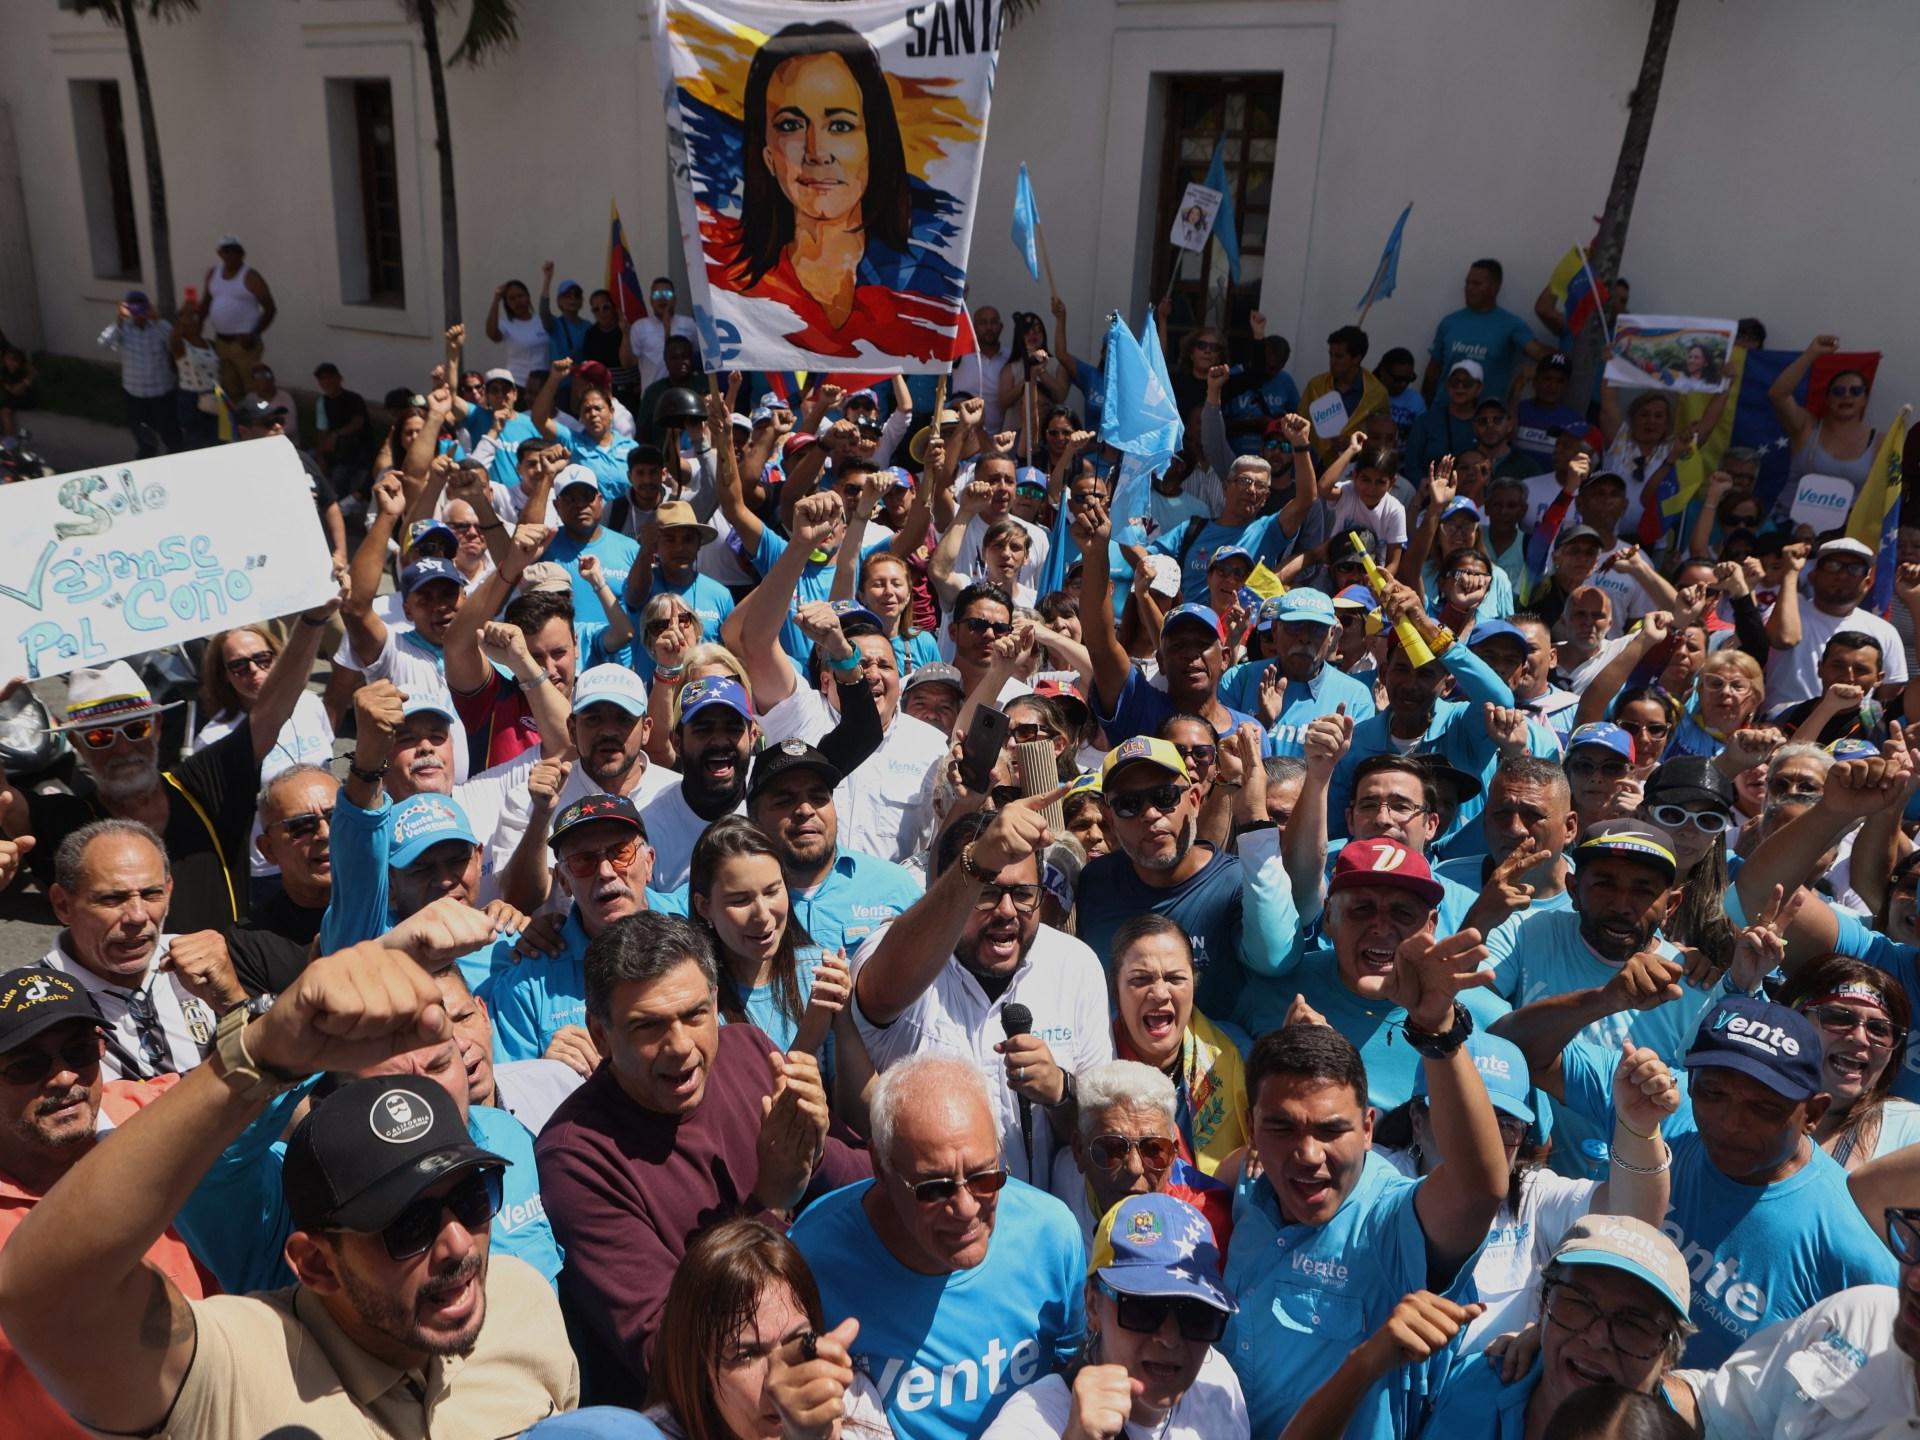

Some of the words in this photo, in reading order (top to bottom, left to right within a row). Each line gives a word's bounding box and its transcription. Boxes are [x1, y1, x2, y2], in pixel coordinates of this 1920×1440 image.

[1313, 400, 1342, 422] Vente
[1798, 488, 1847, 508] Vente
[416, 558, 445, 573] NY
[270, 733, 321, 763] ente
[852, 904, 893, 918] Vente
[18, 974, 42, 987] Con
[46, 975, 75, 993] Todo
[1030, 1025, 1072, 1041] ente
[1712, 1009, 1800, 1056] Vente
[1474, 1055, 1510, 1073] nte
[386, 1115, 430, 1137] CALIFORNIA
[497, 1192, 544, 1231] Vent
[1488, 1222, 1529, 1244] ente
[1292, 1250, 1348, 1279] Vente
[1660, 1218, 1766, 1322] ente
